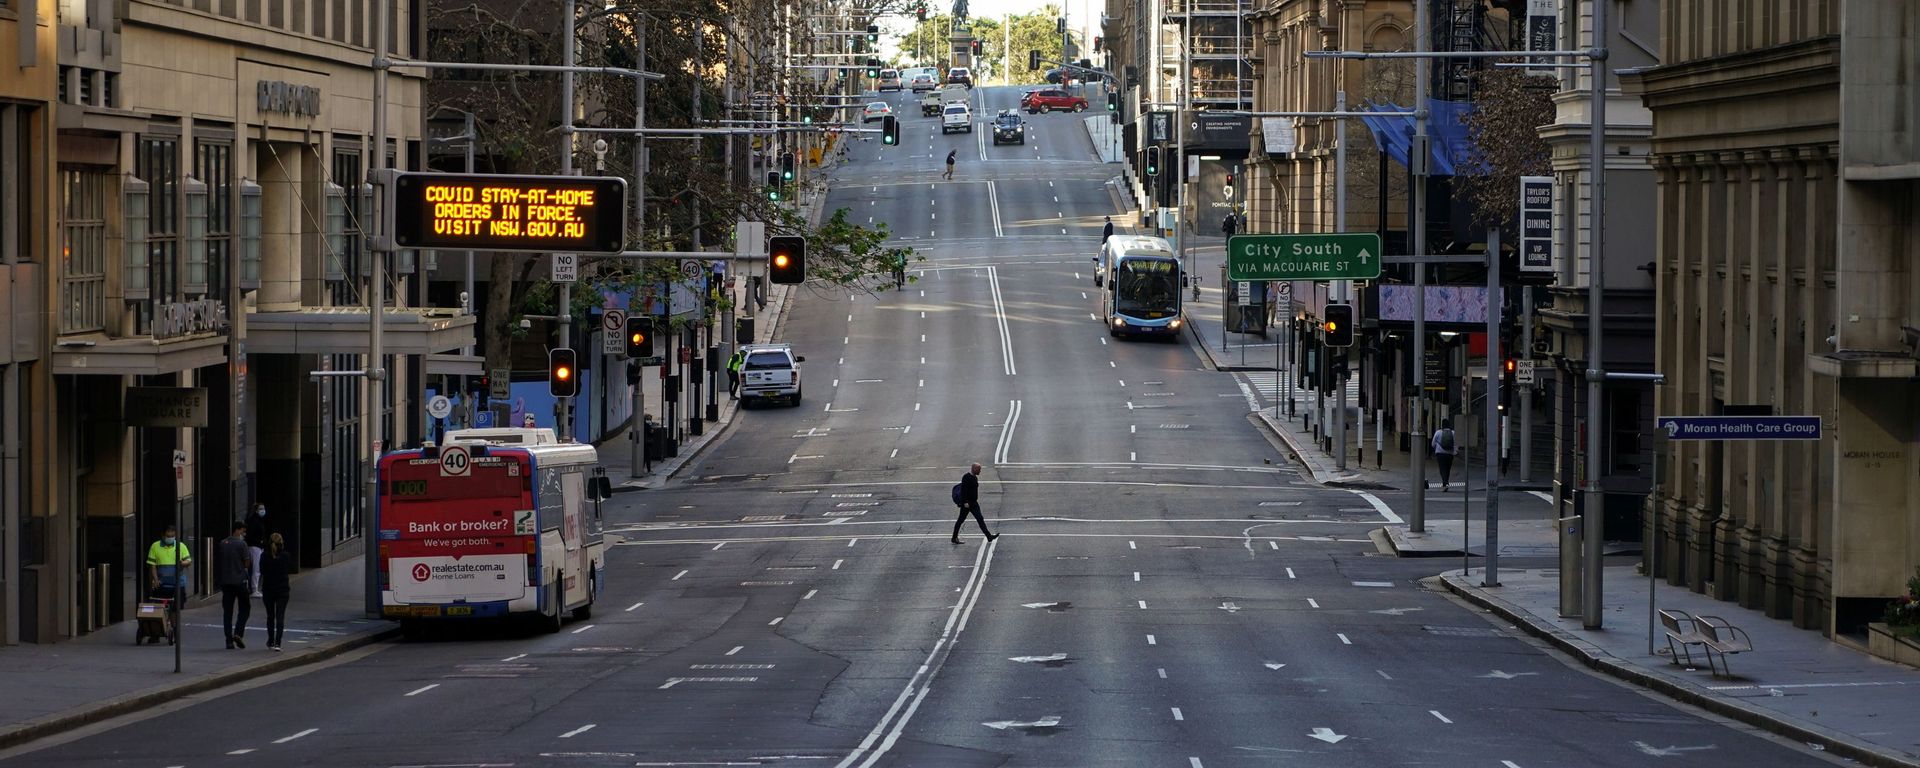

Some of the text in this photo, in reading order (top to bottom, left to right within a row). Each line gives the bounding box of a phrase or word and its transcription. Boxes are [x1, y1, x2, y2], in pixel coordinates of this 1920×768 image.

[1534, 1, 1553, 9] THE
[426, 187, 595, 206] COVID STAY-AT-HOME
[1526, 188, 1550, 196] TAYLOR'S
[1526, 196, 1550, 204] ROOFTOP
[435, 203, 582, 221] ORDERS IN FORCE.
[435, 220, 585, 237] VISIT NSW.GOV.AU
[1526, 219, 1550, 229] DINING
[1245, 242, 1342, 258] City South
[1533, 245, 1542, 253] VIP
[558, 256, 573, 265] NO
[1528, 253, 1547, 261] LOUNGE
[685, 265, 698, 275] 40
[1237, 261, 1350, 273] VIA MACQUARIE ST
[493, 370, 508, 378] ONE
[493, 380, 508, 388] WAY
[1684, 422, 1816, 434] Moran Health Care Group
[445, 453, 466, 468] 40
[409, 519, 508, 533] Bank or broker?
[424, 537, 492, 548] We've got both.
[432, 563, 504, 573] realestate.com.au
[455, 572, 474, 580] Loans
